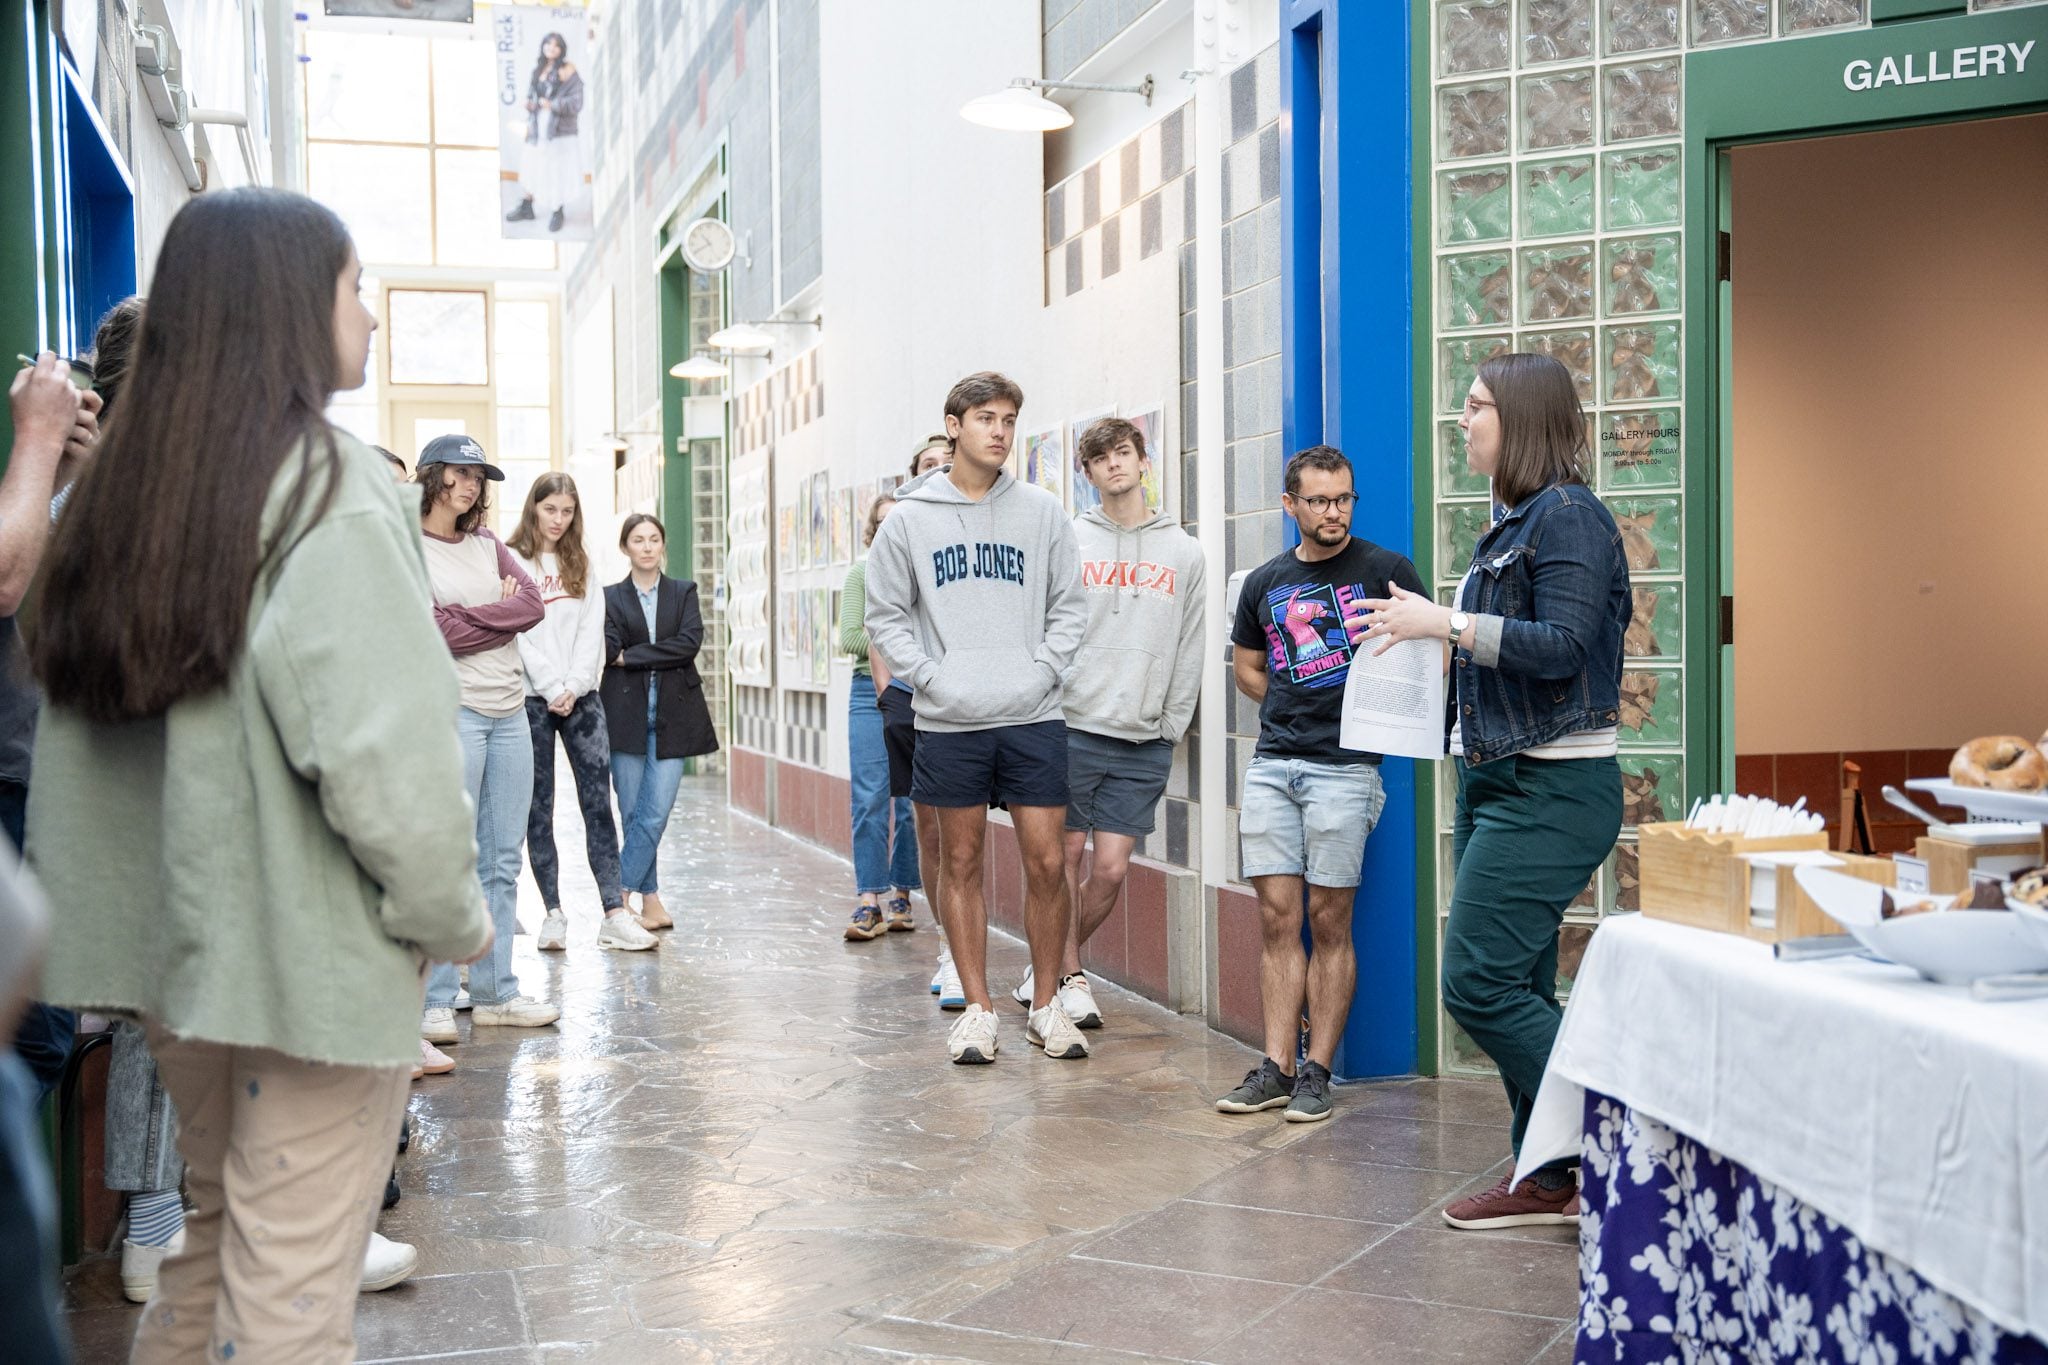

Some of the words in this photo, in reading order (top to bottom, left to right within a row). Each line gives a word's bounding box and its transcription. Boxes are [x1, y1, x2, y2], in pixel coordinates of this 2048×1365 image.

[497, 15, 514, 52] Rick
[500, 59, 516, 106] Cami
[1843, 40, 2036, 92] GALLERY
[1601, 430, 1644, 441] GALLERY
[1647, 428, 1680, 438] HOURS
[1602, 450, 1628, 458] MONDAY
[1630, 449, 1653, 457] through
[933, 544, 968, 588] BOB
[973, 543, 1025, 587] JONES
[1082, 561, 1177, 595] NACA
[1296, 650, 1346, 679] FORTNITE
